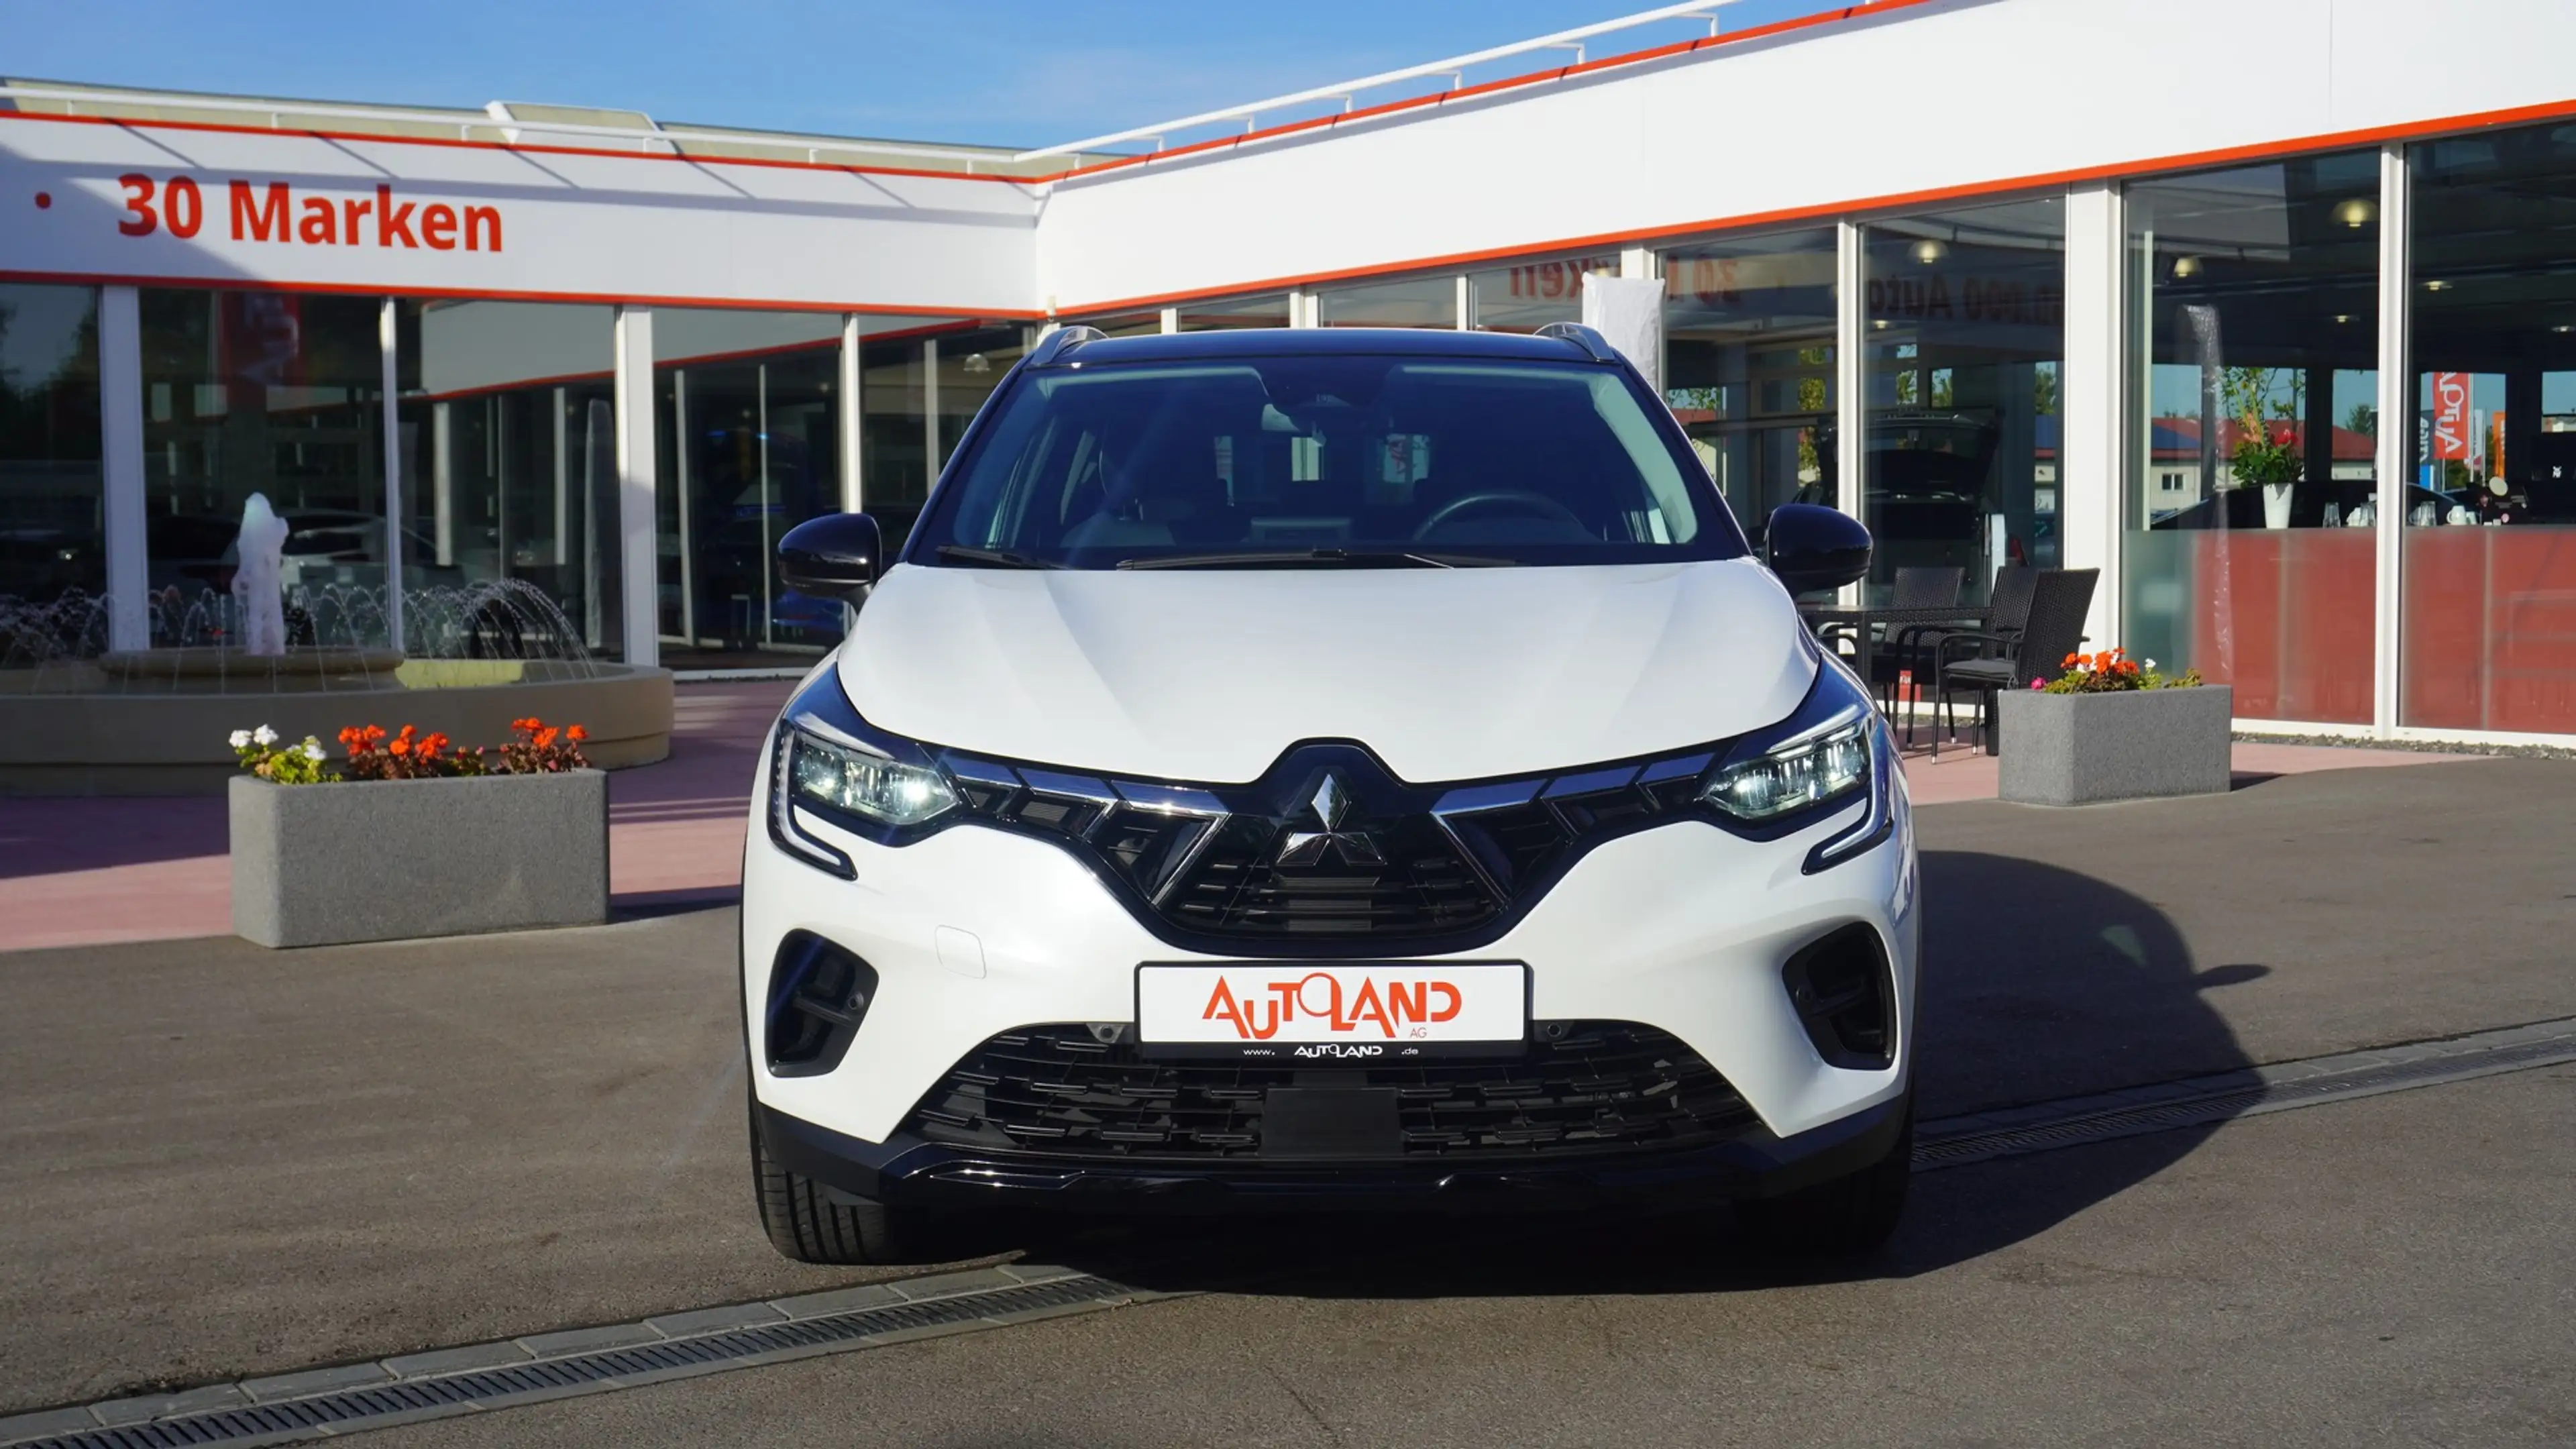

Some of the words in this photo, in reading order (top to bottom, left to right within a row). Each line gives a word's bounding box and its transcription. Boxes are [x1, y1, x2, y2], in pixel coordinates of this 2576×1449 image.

[117, 172, 203, 239] 30
[228, 178, 502, 252] Marken
[1201, 972, 1462, 1040] AUTOLAND
[1293, 1044, 1383, 1058] AUTOLAND
[1409, 1027, 1428, 1038] AG
